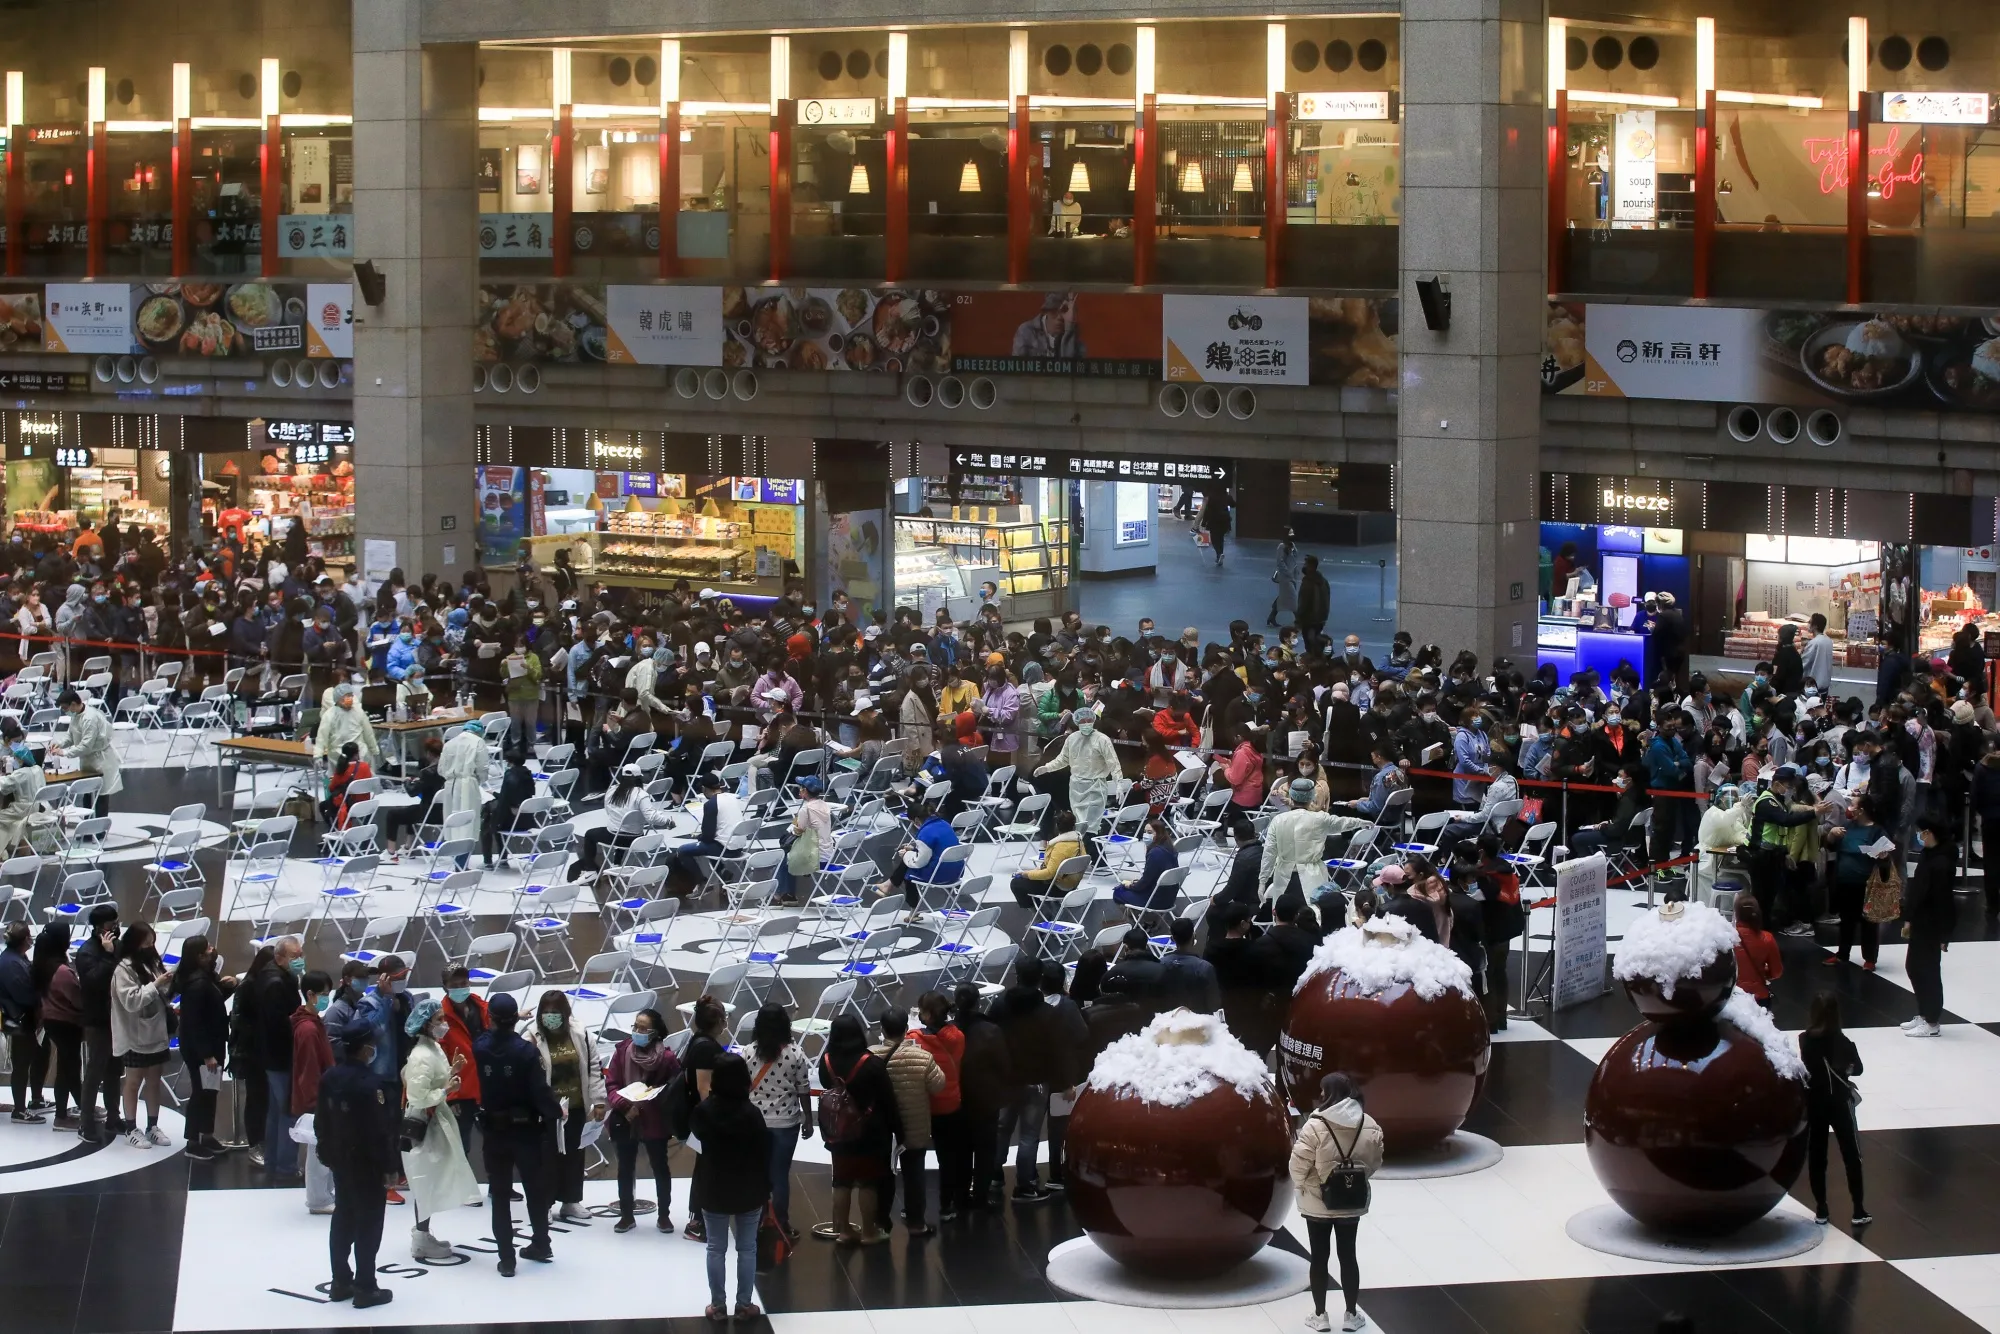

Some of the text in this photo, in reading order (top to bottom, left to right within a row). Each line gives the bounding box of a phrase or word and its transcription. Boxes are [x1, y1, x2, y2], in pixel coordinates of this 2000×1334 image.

[1629, 178, 1653, 188] soup.
[1878, 153, 1923, 199] Good
[310, 224, 346, 249] 三角
[502, 222, 542, 249] 三角
[81, 301, 105, 316] 浜町
[639, 309, 692, 332] 韓虎嘯
[47, 340, 59, 350] 2F
[309, 345, 322, 354] 2F
[1642, 341, 1721, 361] 新高軒
[609, 350, 623, 360] 2F
[1256, 349, 1287, 367] 三和
[956, 359, 1072, 373] BREEZEONLINE.COM
[1170, 366, 1188, 377] 2F
[1587, 380, 1607, 392] 2F
[20, 419, 59, 435] Breeze
[280, 422, 297, 435] 月台
[593, 441, 643, 459] Breeze
[971, 453, 984, 462] 月台
[1033, 456, 1047, 466] 高鐵
[1132, 462, 1159, 471] 台北捷運
[1603, 489, 1670, 511] Breeze
[1603, 524, 1628, 537] open
[1570, 869, 1596, 887] COVID-19
